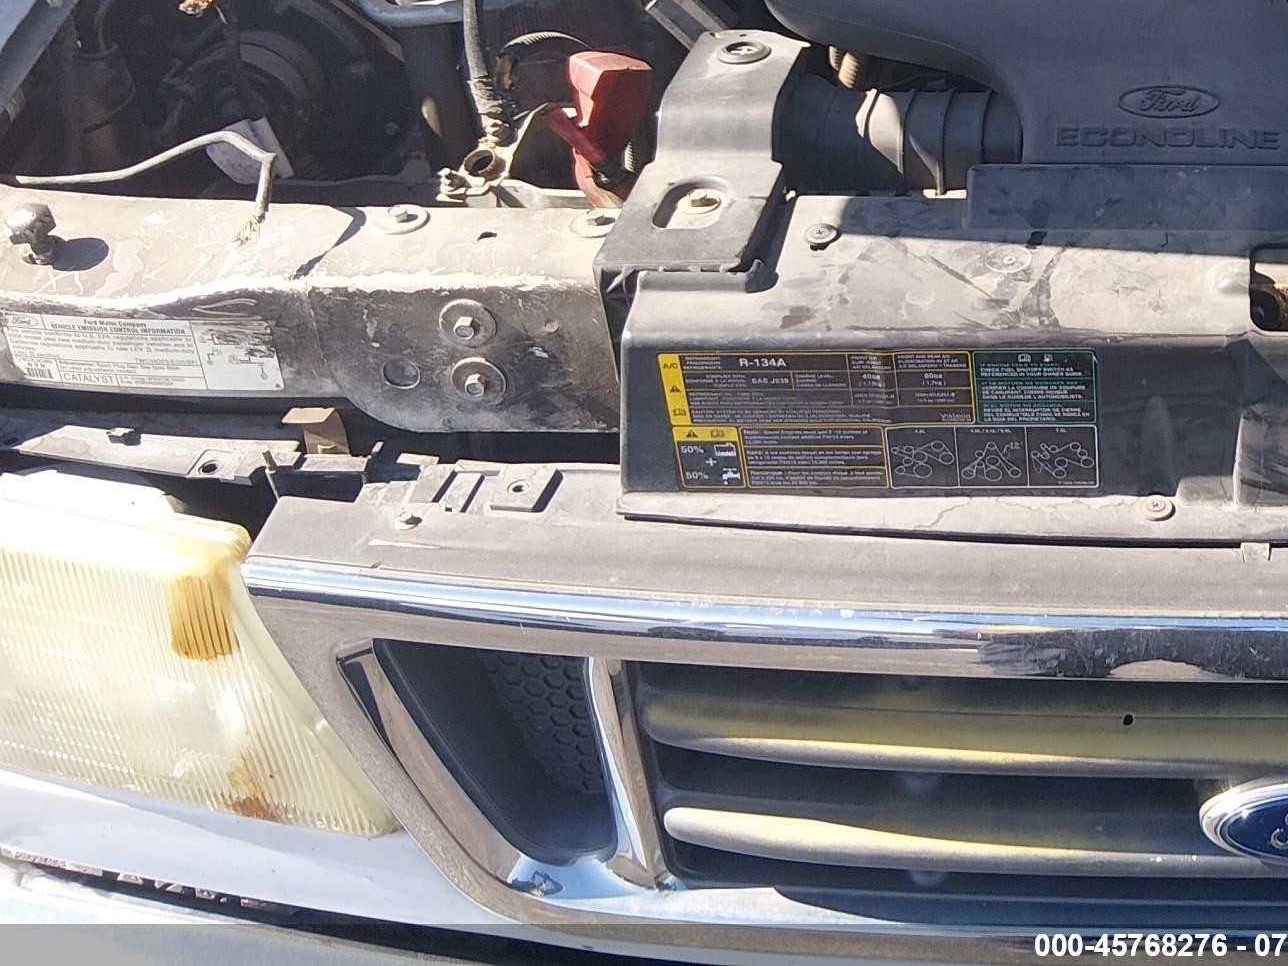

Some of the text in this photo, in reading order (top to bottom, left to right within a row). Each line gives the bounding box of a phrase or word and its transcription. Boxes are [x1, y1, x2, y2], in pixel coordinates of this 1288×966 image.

[1139, 89, 1199, 113] Ford
[1055, 126, 1281, 150] ECONOLINE
[78, 325, 108, 333] EMISSION
[118, 321, 147, 329] Company
[663, 362, 678, 370] A/C
[738, 358, 787, 368] R-134A
[63, 372, 115, 384] CATALYST
[862, 372, 881, 380] 40oz
[681, 446, 704, 454] 50%
[686, 472, 709, 480] 50%
